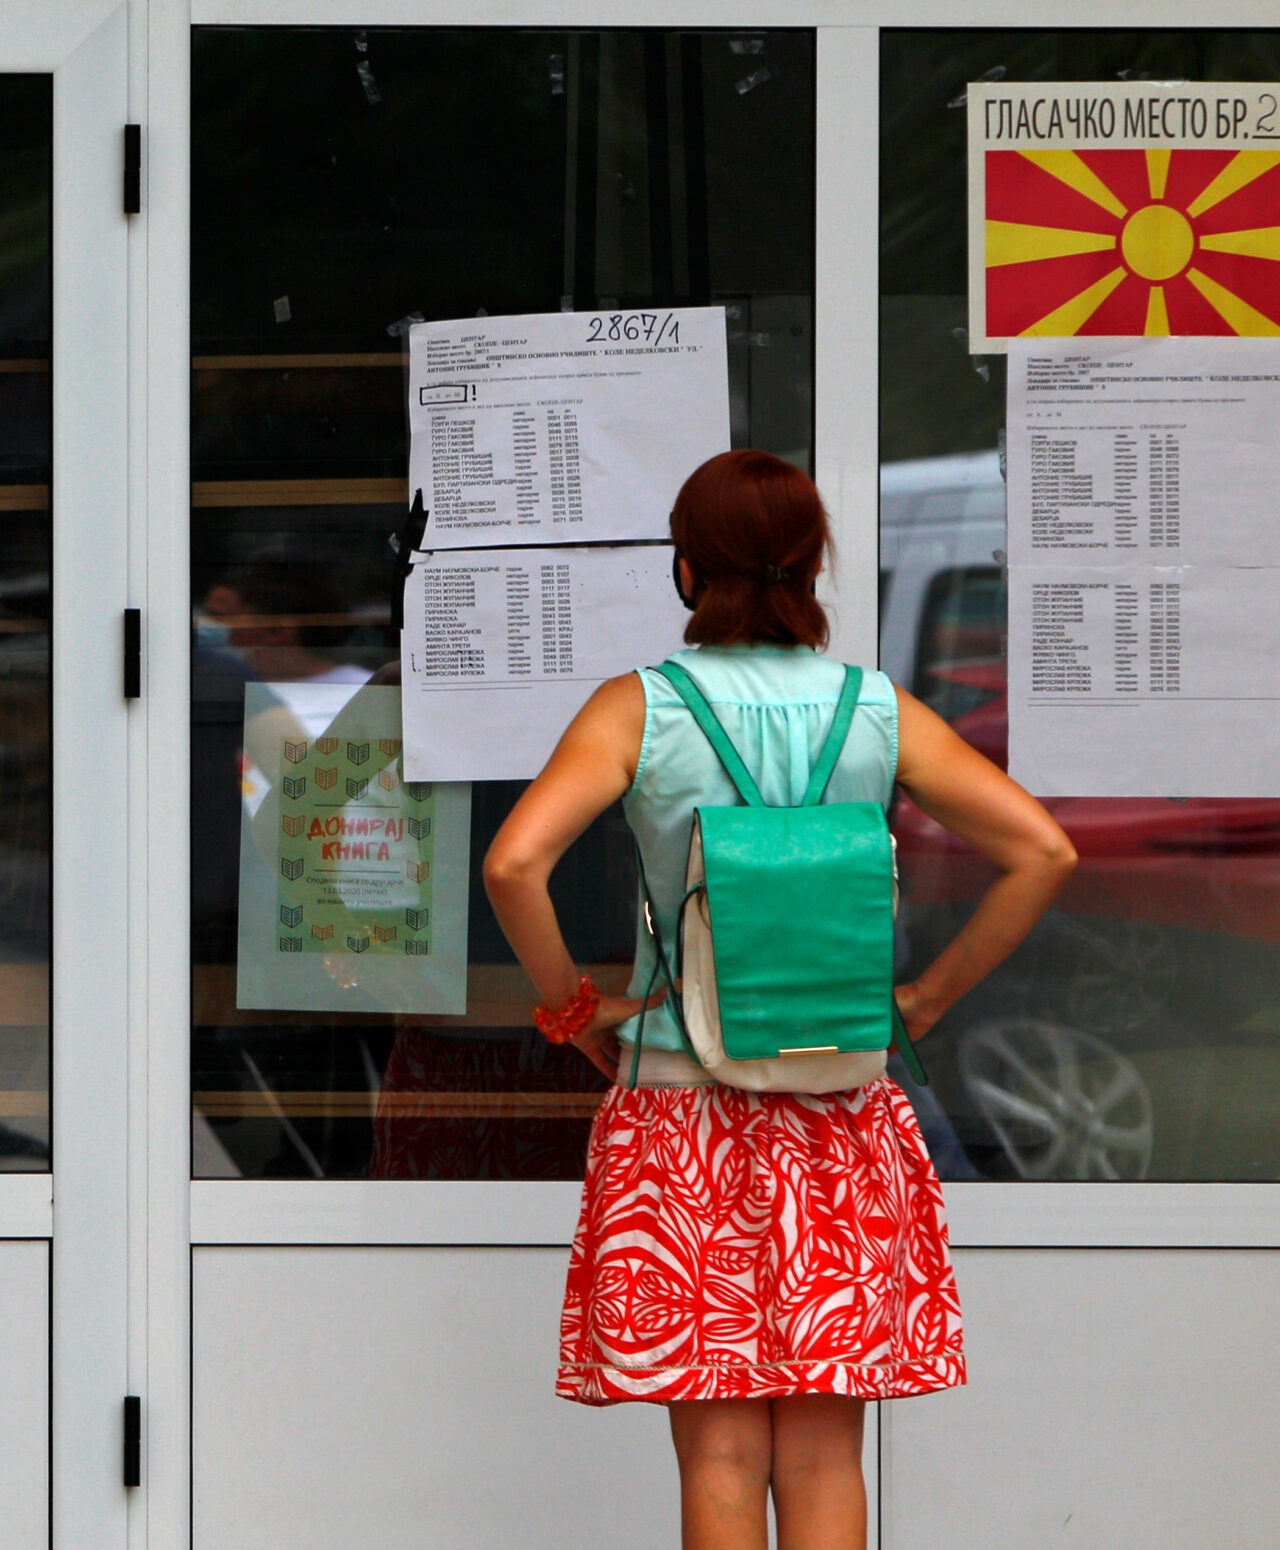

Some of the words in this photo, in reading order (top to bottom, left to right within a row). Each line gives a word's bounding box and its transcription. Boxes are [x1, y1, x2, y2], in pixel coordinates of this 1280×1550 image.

[985, 98, 1115, 139] ГЛАСАЧКО
[1124, 98, 1207, 138] МЕСТО
[1216, 99, 1249, 139] БР.
[586, 313, 679, 346] 2867/1
[307, 816, 404, 842] ДОНИРАЈ
[322, 841, 390, 861] КНИГА
